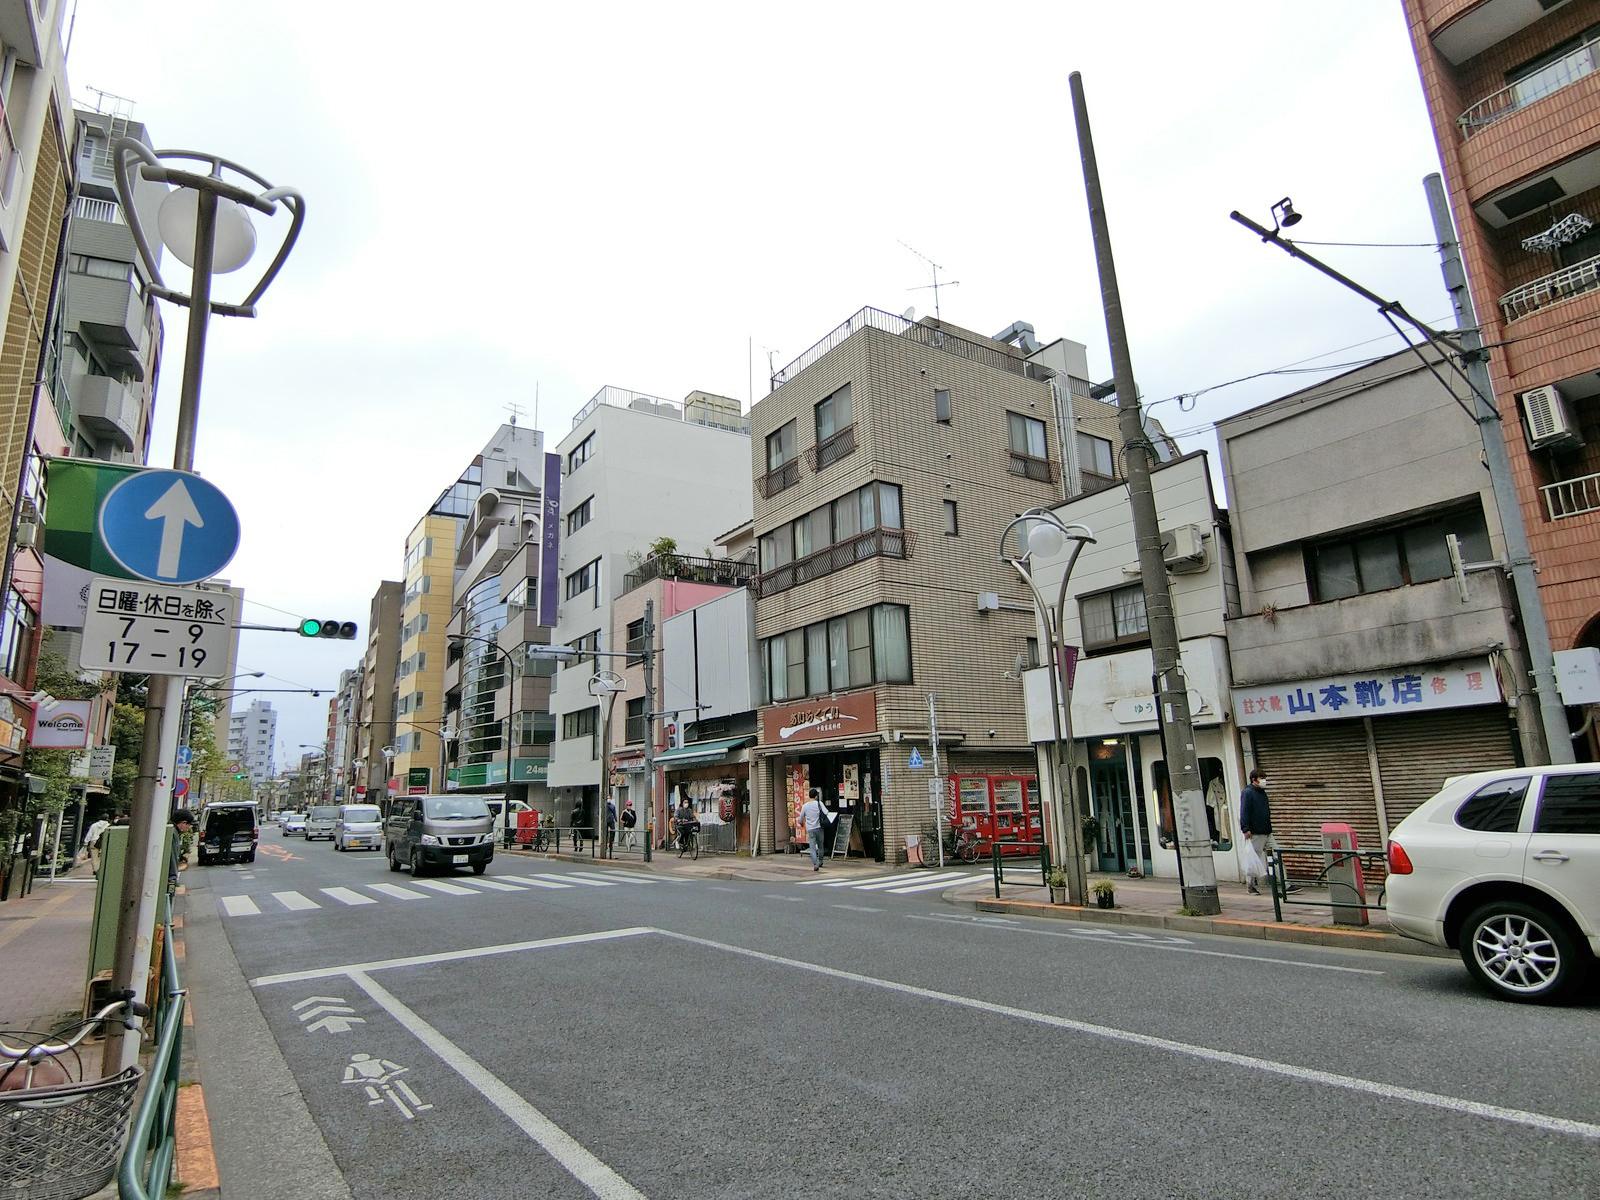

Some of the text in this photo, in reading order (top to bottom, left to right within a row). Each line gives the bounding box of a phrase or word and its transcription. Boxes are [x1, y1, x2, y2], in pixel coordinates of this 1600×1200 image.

[98, 588, 226, 621] 日曜・休日を除く
[1286, 674, 1424, 715] 山本靴店
[38, 720, 84, 728] Welcome
[789, 705, 840, 726] あいらくてい
